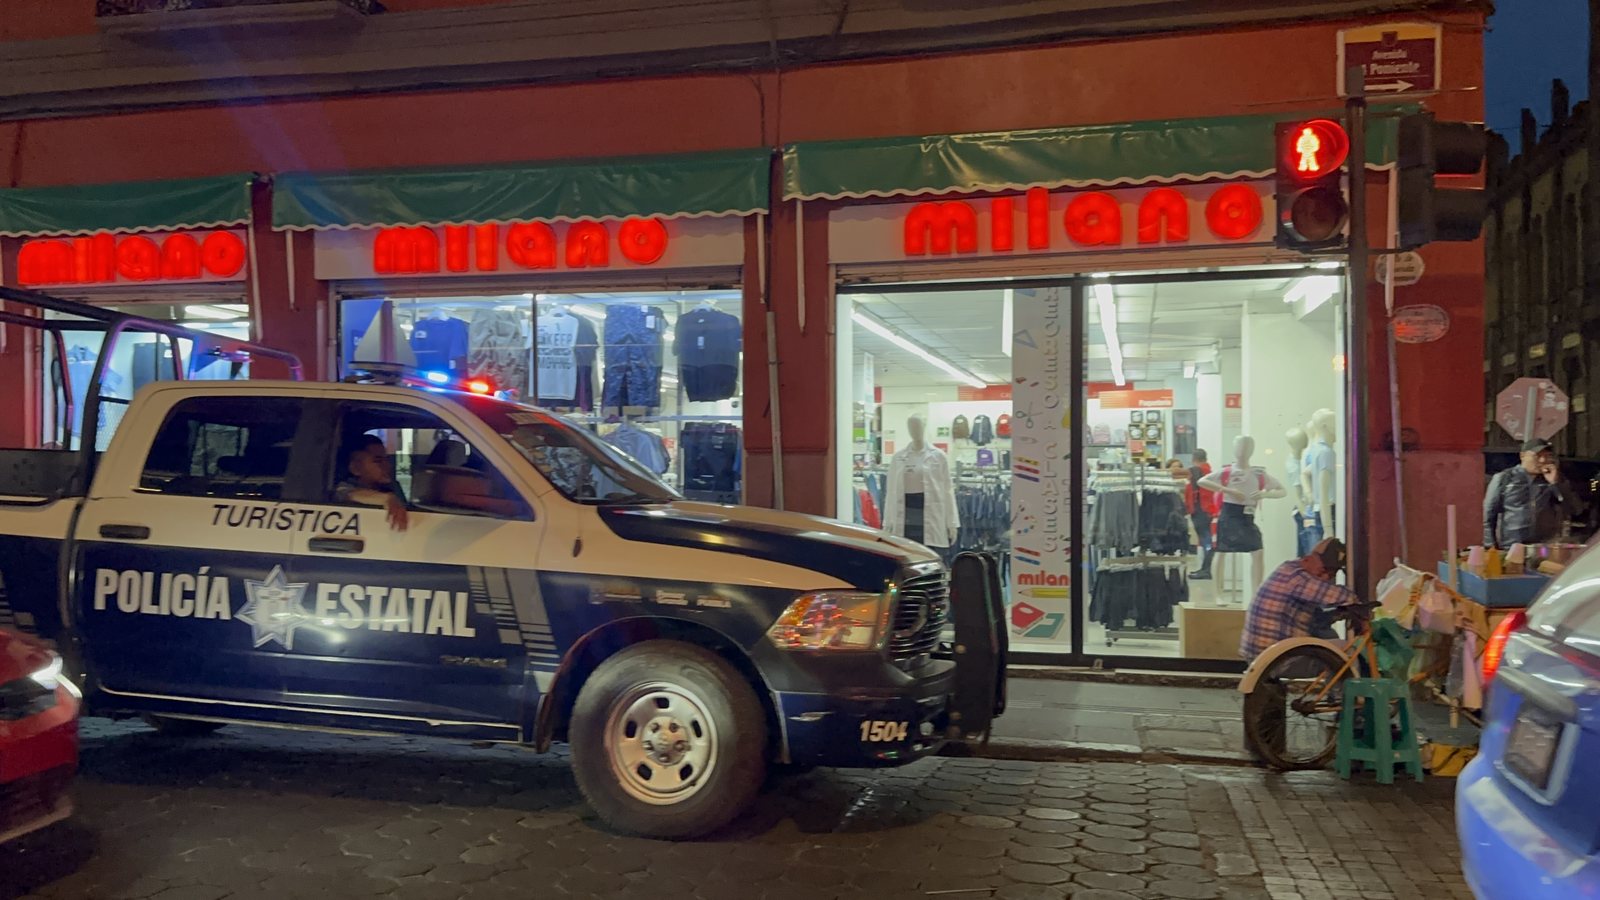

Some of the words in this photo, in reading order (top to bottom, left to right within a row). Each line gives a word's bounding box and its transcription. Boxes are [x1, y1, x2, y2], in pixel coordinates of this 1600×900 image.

[1370, 61, 1420, 75] Poniente
[904, 184, 1262, 255] milano
[18, 230, 246, 285] milano
[374, 218, 668, 273] milano
[210, 502, 361, 536] TURÍSTICA
[1017, 569, 1069, 586] milan
[94, 566, 232, 620] POLICÍA
[313, 582, 476, 638] ESTATAL
[860, 720, 909, 742] 1504
